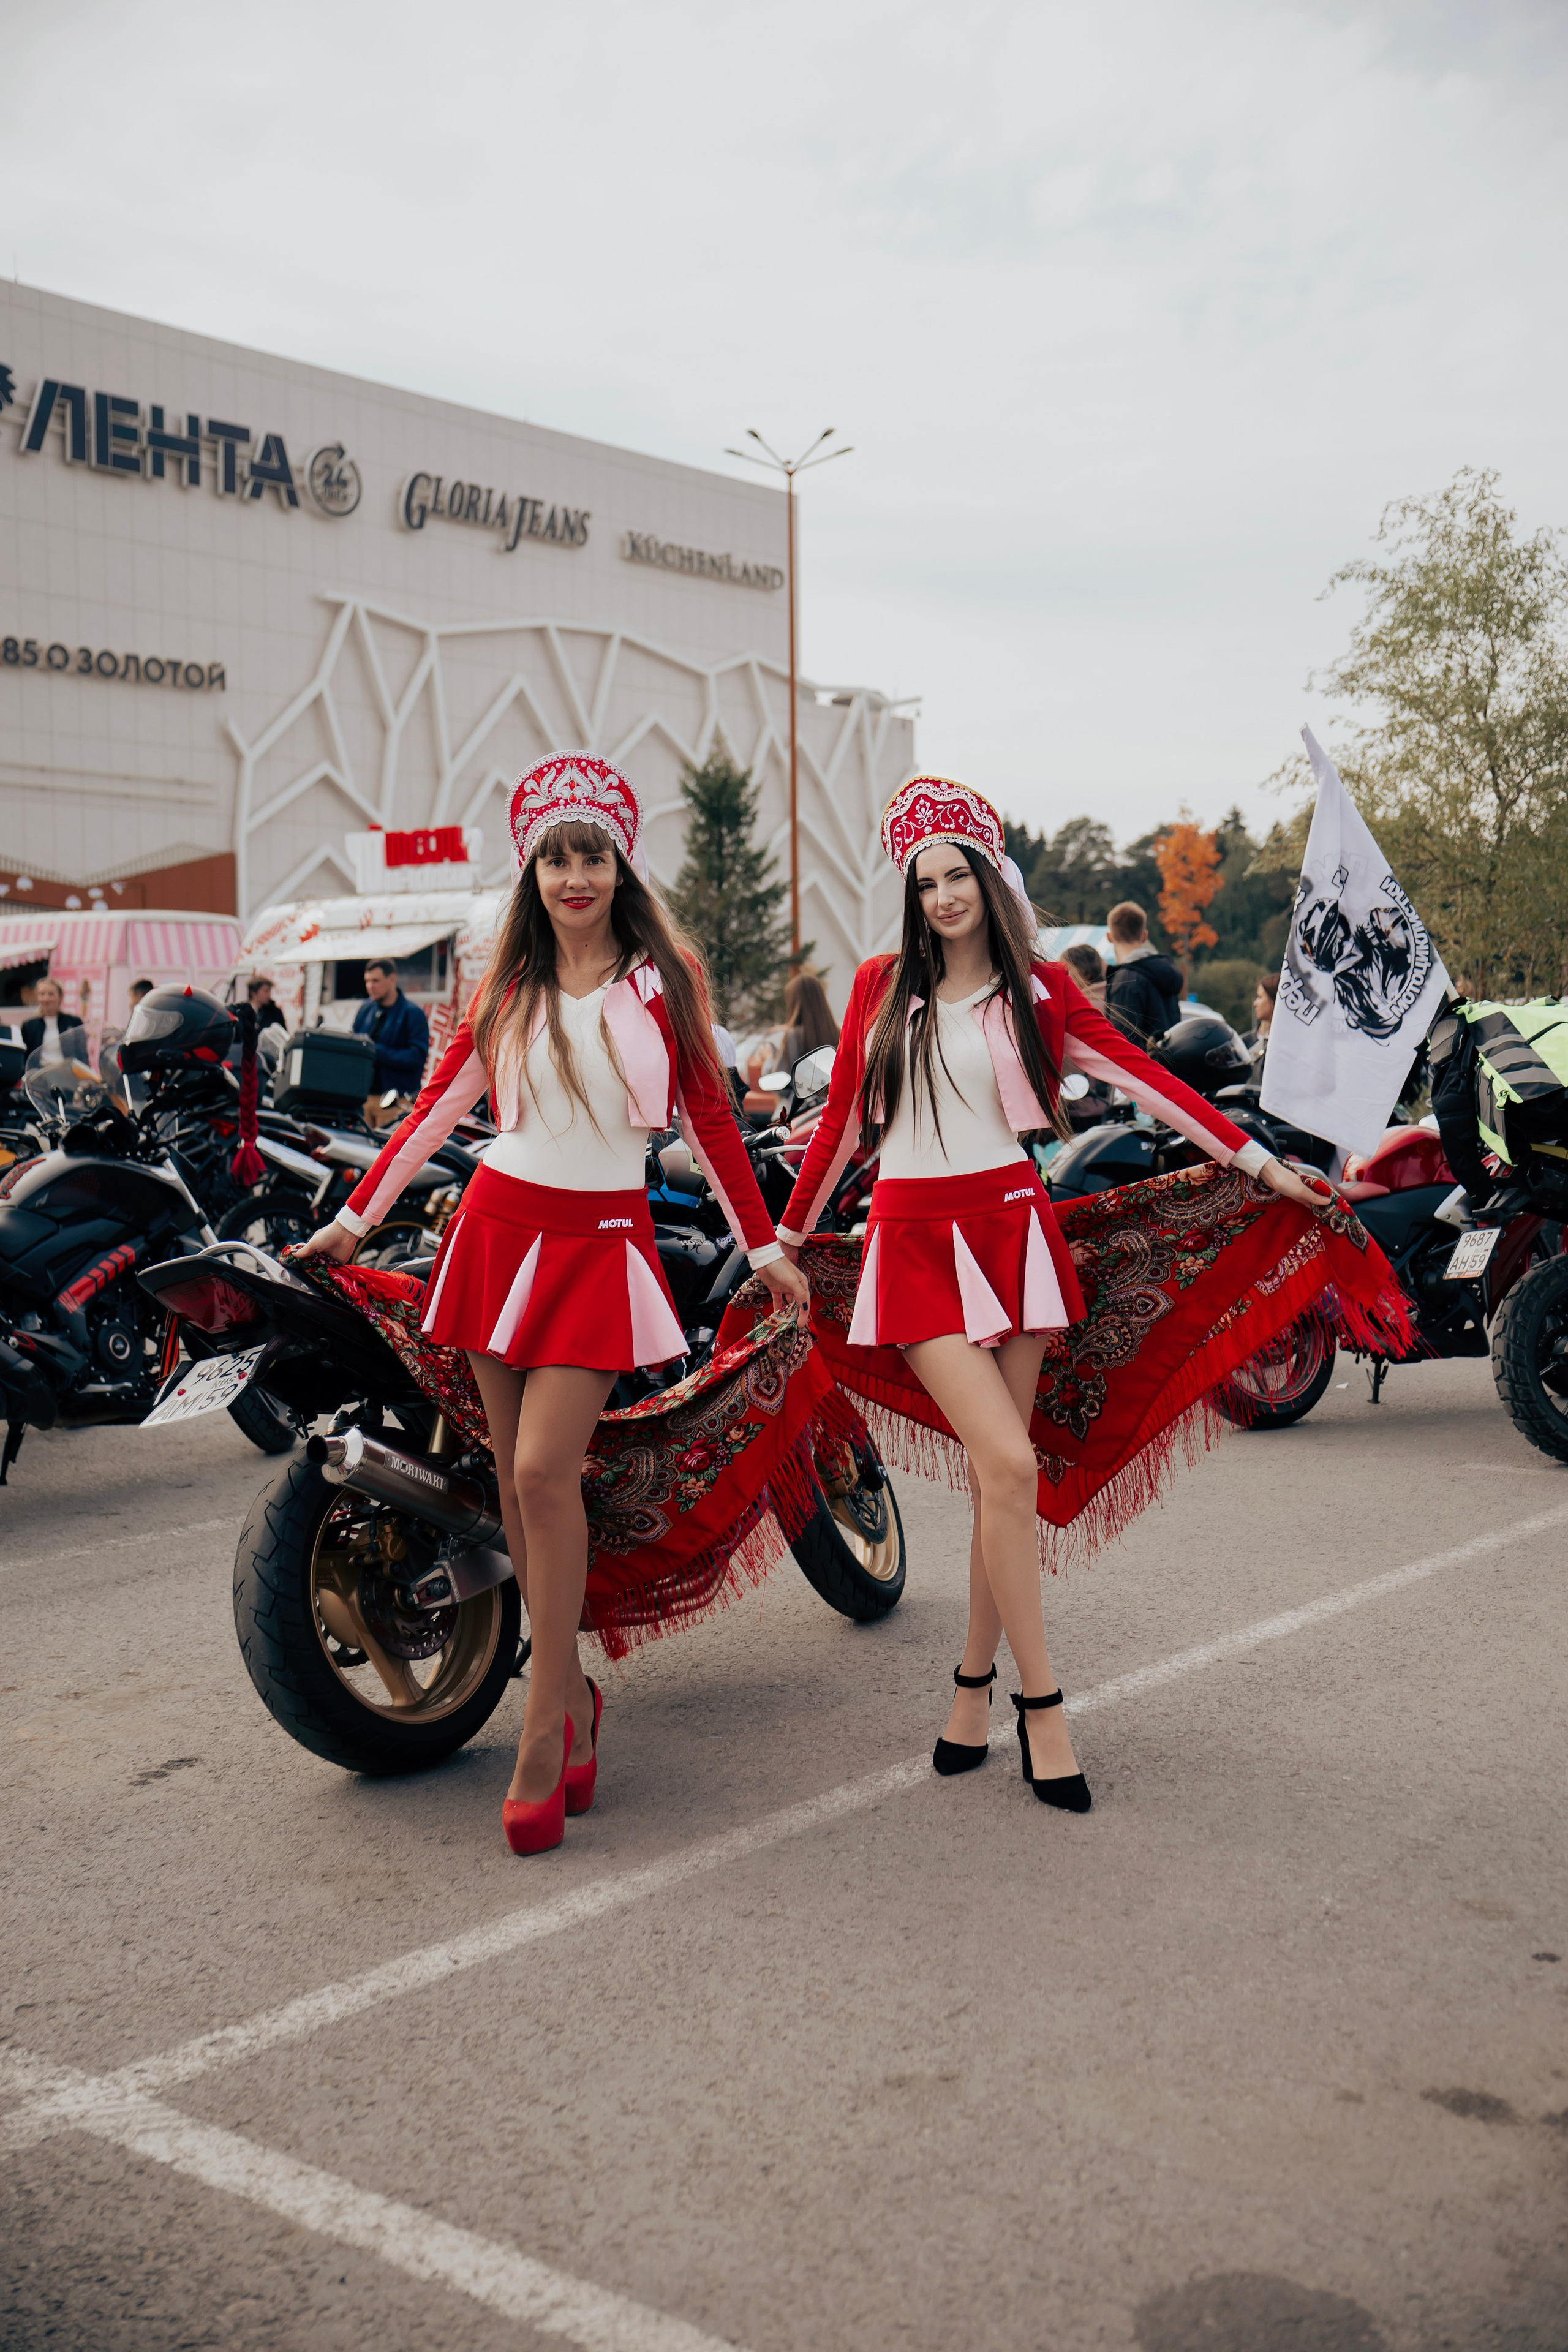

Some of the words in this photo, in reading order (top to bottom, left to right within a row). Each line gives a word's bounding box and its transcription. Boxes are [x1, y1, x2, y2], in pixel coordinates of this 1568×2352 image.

[23, 377, 300, 508] ЛЕНТА
[1004, 1187, 1036, 1202] MOTUL
[598, 1218, 634, 1229] MOTUL
[1463, 1231, 1494, 1248] 9687
[1470, 1254, 1486, 1268] 59
[191, 1350, 262, 1387] 9625
[211, 1376, 236, 1390] RUS
[198, 1383, 239, 1411] 59
[390, 1455, 445, 1490] MORIWAKI
